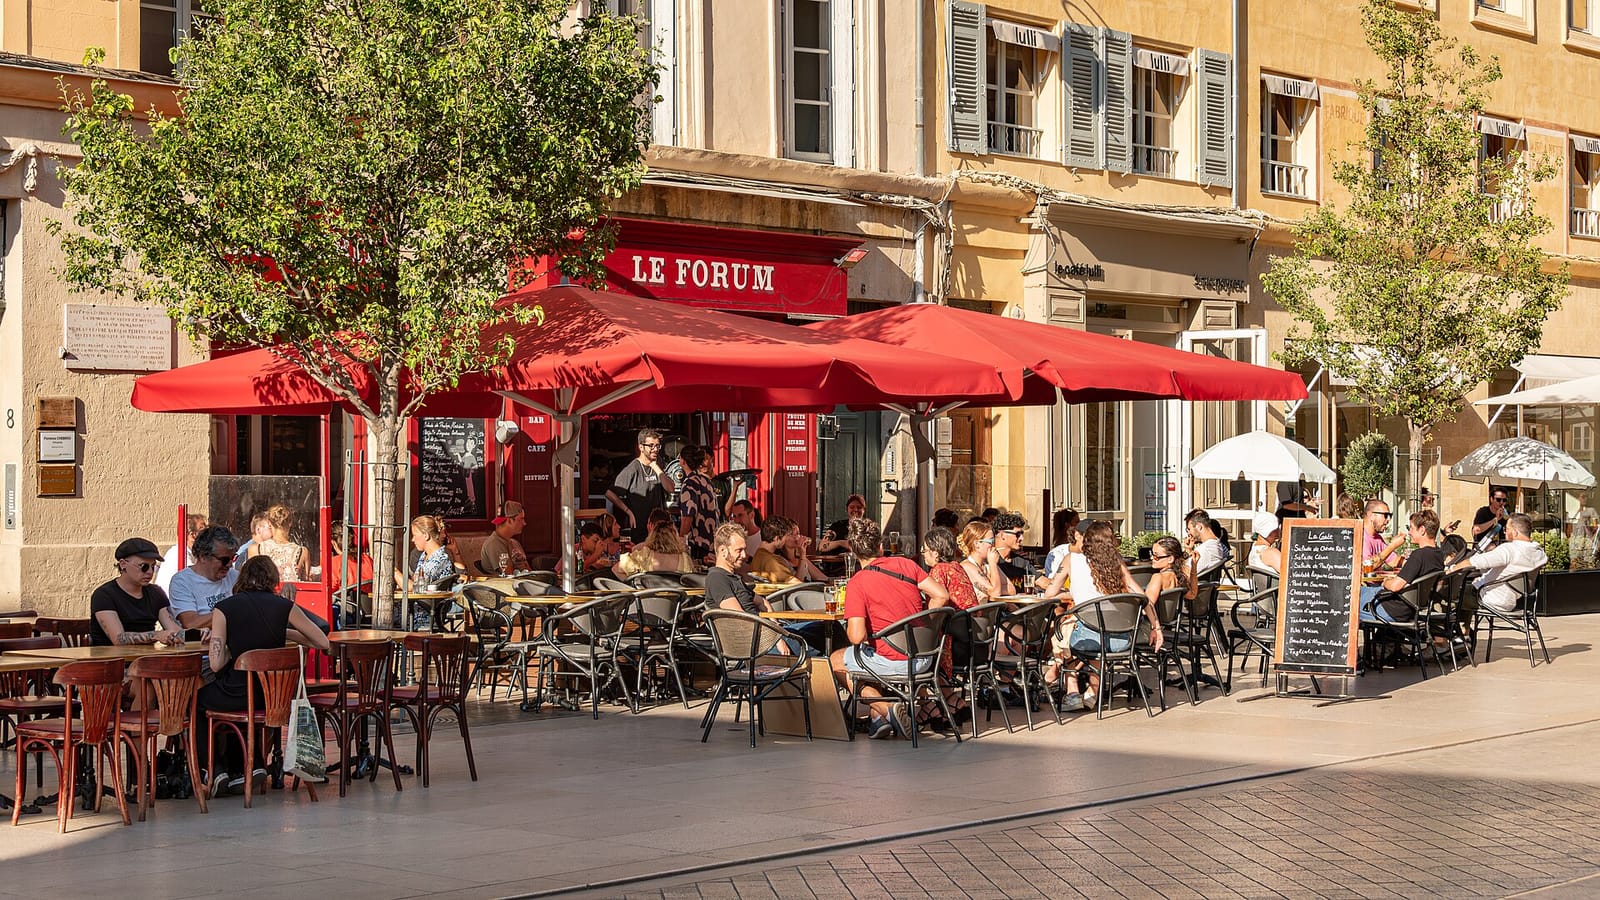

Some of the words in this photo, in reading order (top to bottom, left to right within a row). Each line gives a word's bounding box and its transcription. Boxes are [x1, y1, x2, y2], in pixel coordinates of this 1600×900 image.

[1015, 26, 1037, 47] lulli
[1150, 53, 1170, 72] lulli
[1283, 79, 1301, 97] lulli
[1325, 104, 1366, 125] FABRIQUE
[1496, 121, 1511, 137] lulli
[632, 255, 665, 284] LE
[675, 258, 775, 291] FORUM
[860, 284, 866, 295] 6
[6, 408, 15, 429] 8
[528, 416, 545, 424] BAR
